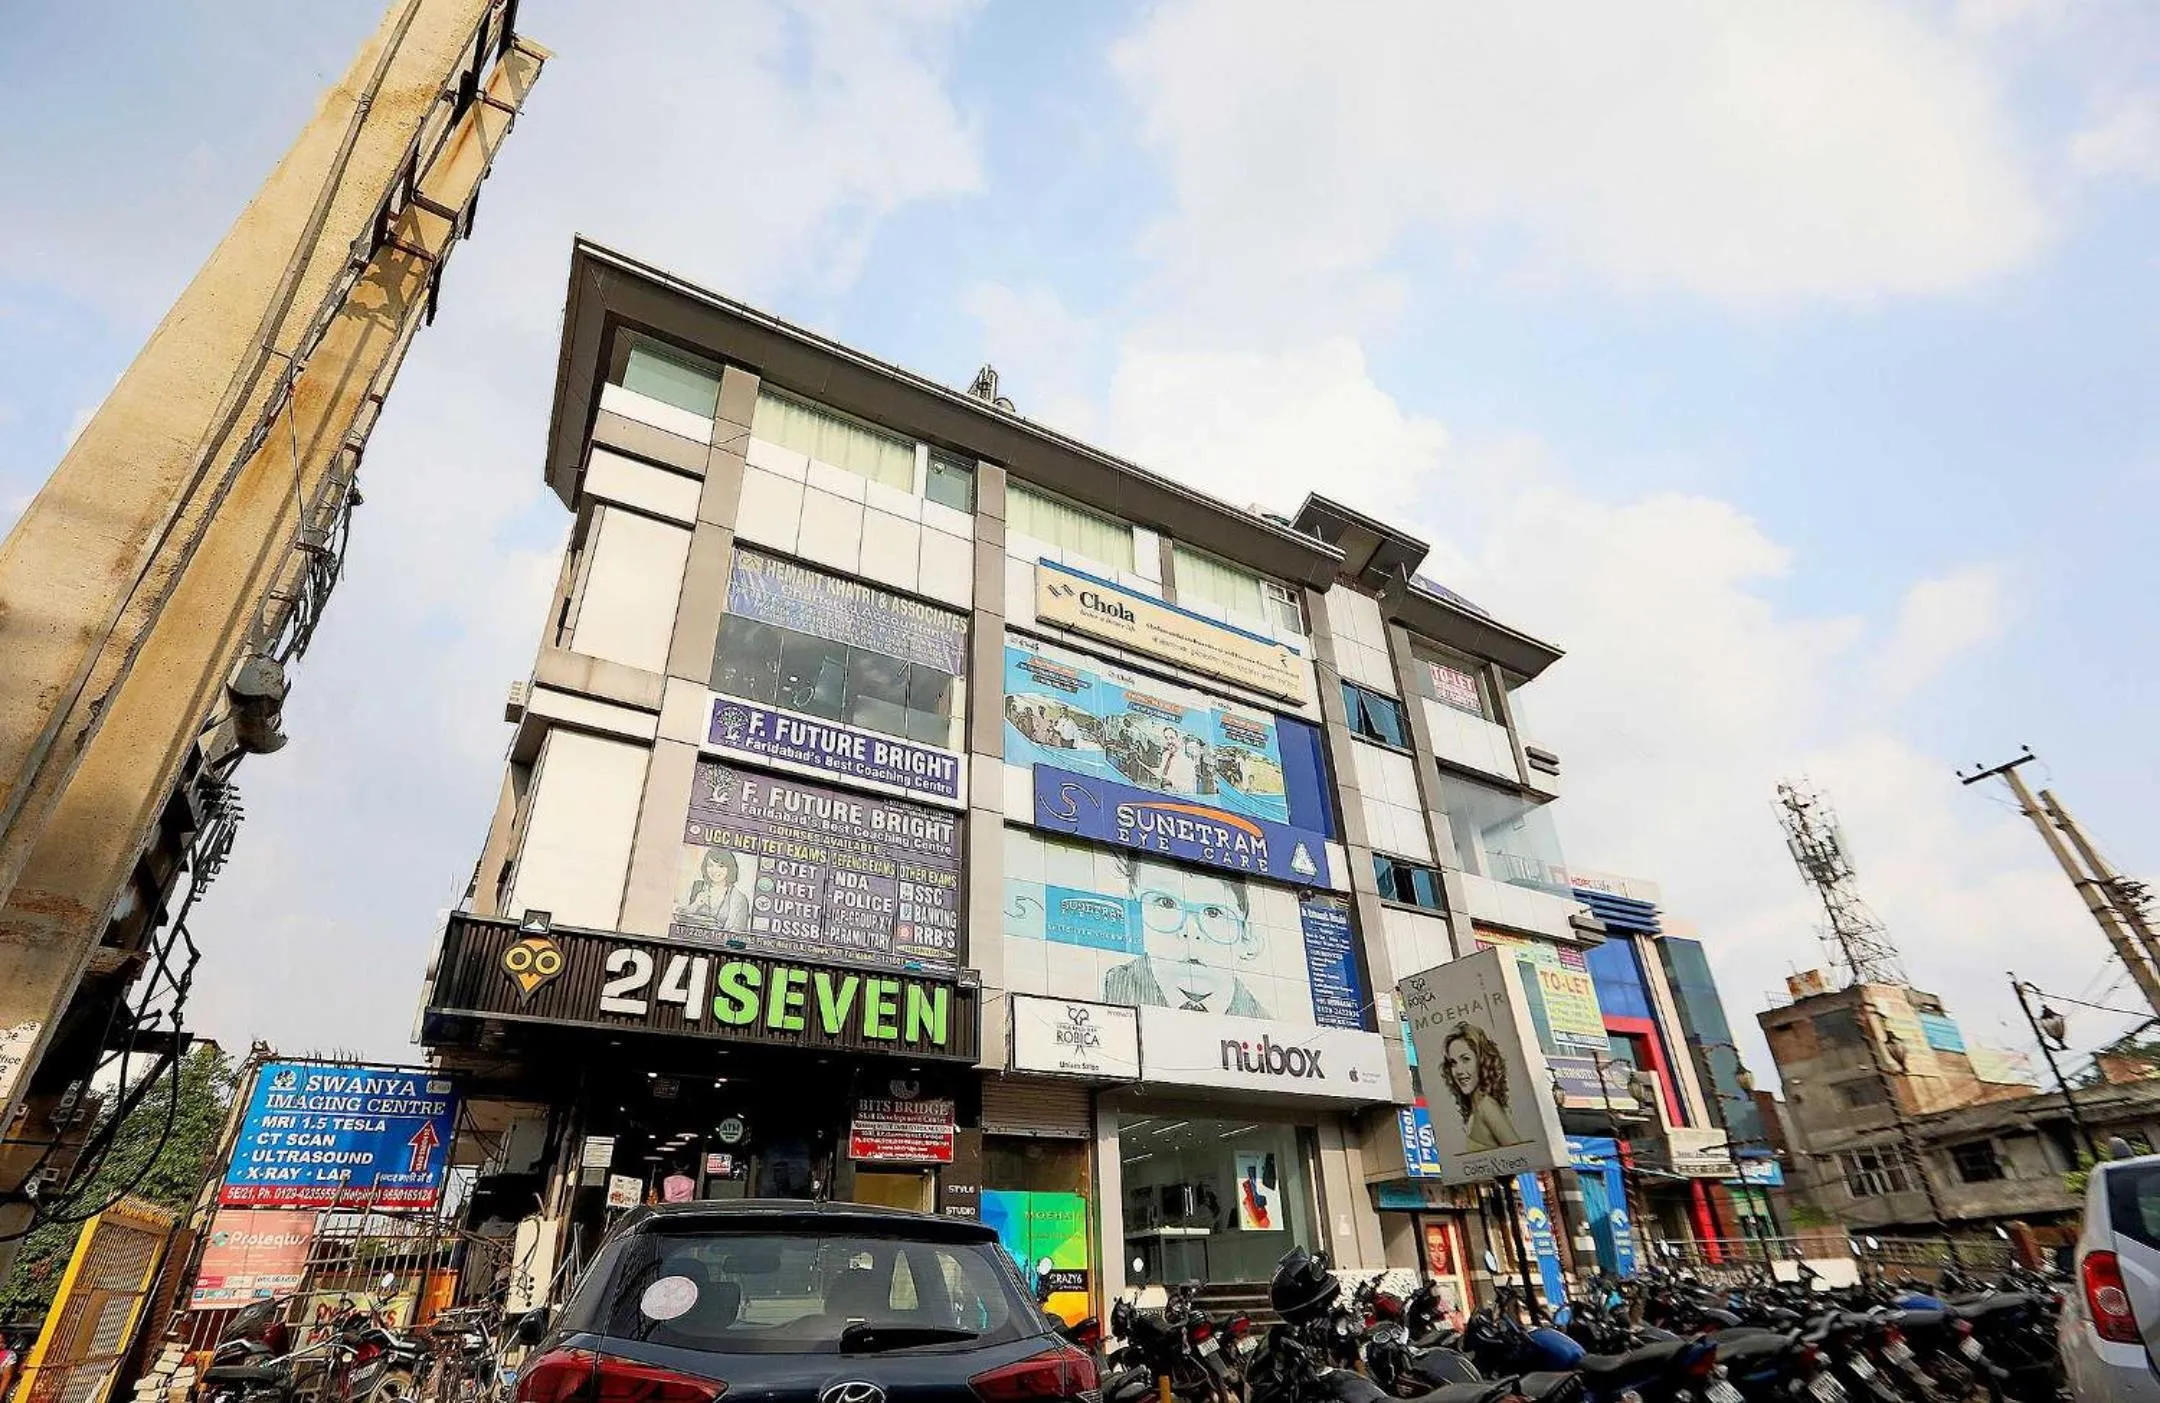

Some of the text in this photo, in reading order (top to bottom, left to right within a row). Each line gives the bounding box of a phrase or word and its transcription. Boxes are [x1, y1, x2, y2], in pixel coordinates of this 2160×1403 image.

[890, 596, 968, 633] ASSOCIATES
[1079, 590, 1136, 624] Chola
[749, 711, 955, 780] F. FUTURE BRIGHT
[745, 737, 954, 795] Faridabad's Best Coaching Centre
[741, 781, 758, 805] F.
[768, 786, 863, 825] FUTURE
[870, 808, 955, 843] BRIGHT
[740, 802, 818, 828] Faridabad's
[822, 819, 851, 835] Best
[854, 825, 911, 848] Coaching
[1116, 804, 1268, 859] SUNETRAM
[704, 828, 758, 851] UGC NET
[761, 838, 828, 864] TET EXAMS
[1117, 827, 1269, 872] EYE CARE
[777, 860, 818, 880] CTET
[900, 865, 957, 890] OTHER EXAMS
[775, 879, 817, 900] HTET
[914, 885, 943, 906] SSC
[773, 899, 822, 920] UPTET
[913, 904, 957, 928] BANKING
[771, 917, 821, 940] DSSSB
[913, 925, 957, 949] RRB'S
[305, 1073, 417, 1097] SWANYA
[265, 1094, 447, 1115] IMAGING CENTRE
[859, 1099, 949, 1116] BITS BRIDGE
[261, 1116, 387, 1132] MRI 1.5 TESLA
[256, 1132, 337, 1147] CT SCAN
[251, 1149, 374, 1165] ULTRASOUND
[245, 1166, 302, 1181] X-RAY
[948, 1184, 975, 1194] STYLE
[945, 1206, 976, 1216] STUDIO
